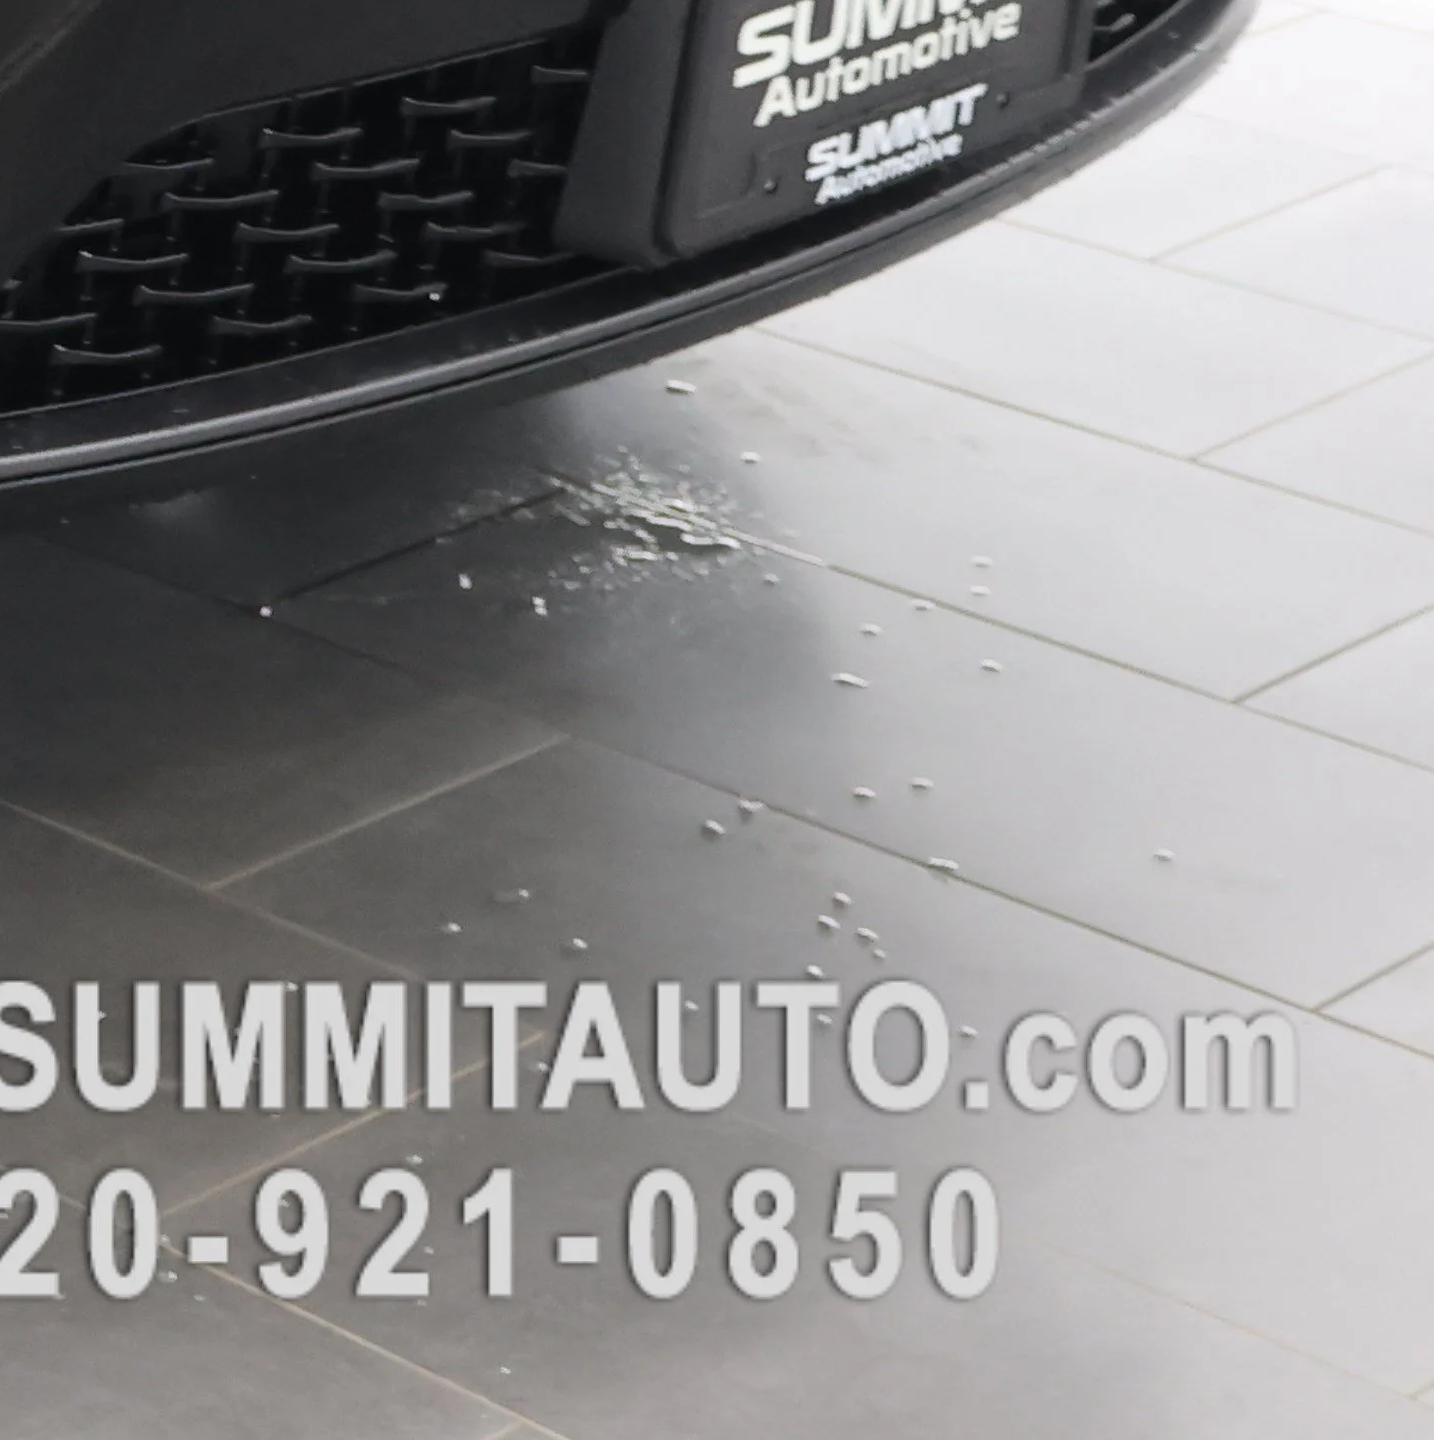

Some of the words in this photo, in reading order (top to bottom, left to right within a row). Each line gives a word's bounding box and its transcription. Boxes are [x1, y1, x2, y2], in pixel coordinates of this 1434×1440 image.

[753, 1, 1022, 128] Automotive
[805, 83, 988, 183] SUMMIT
[814, 132, 963, 206] Automotive
